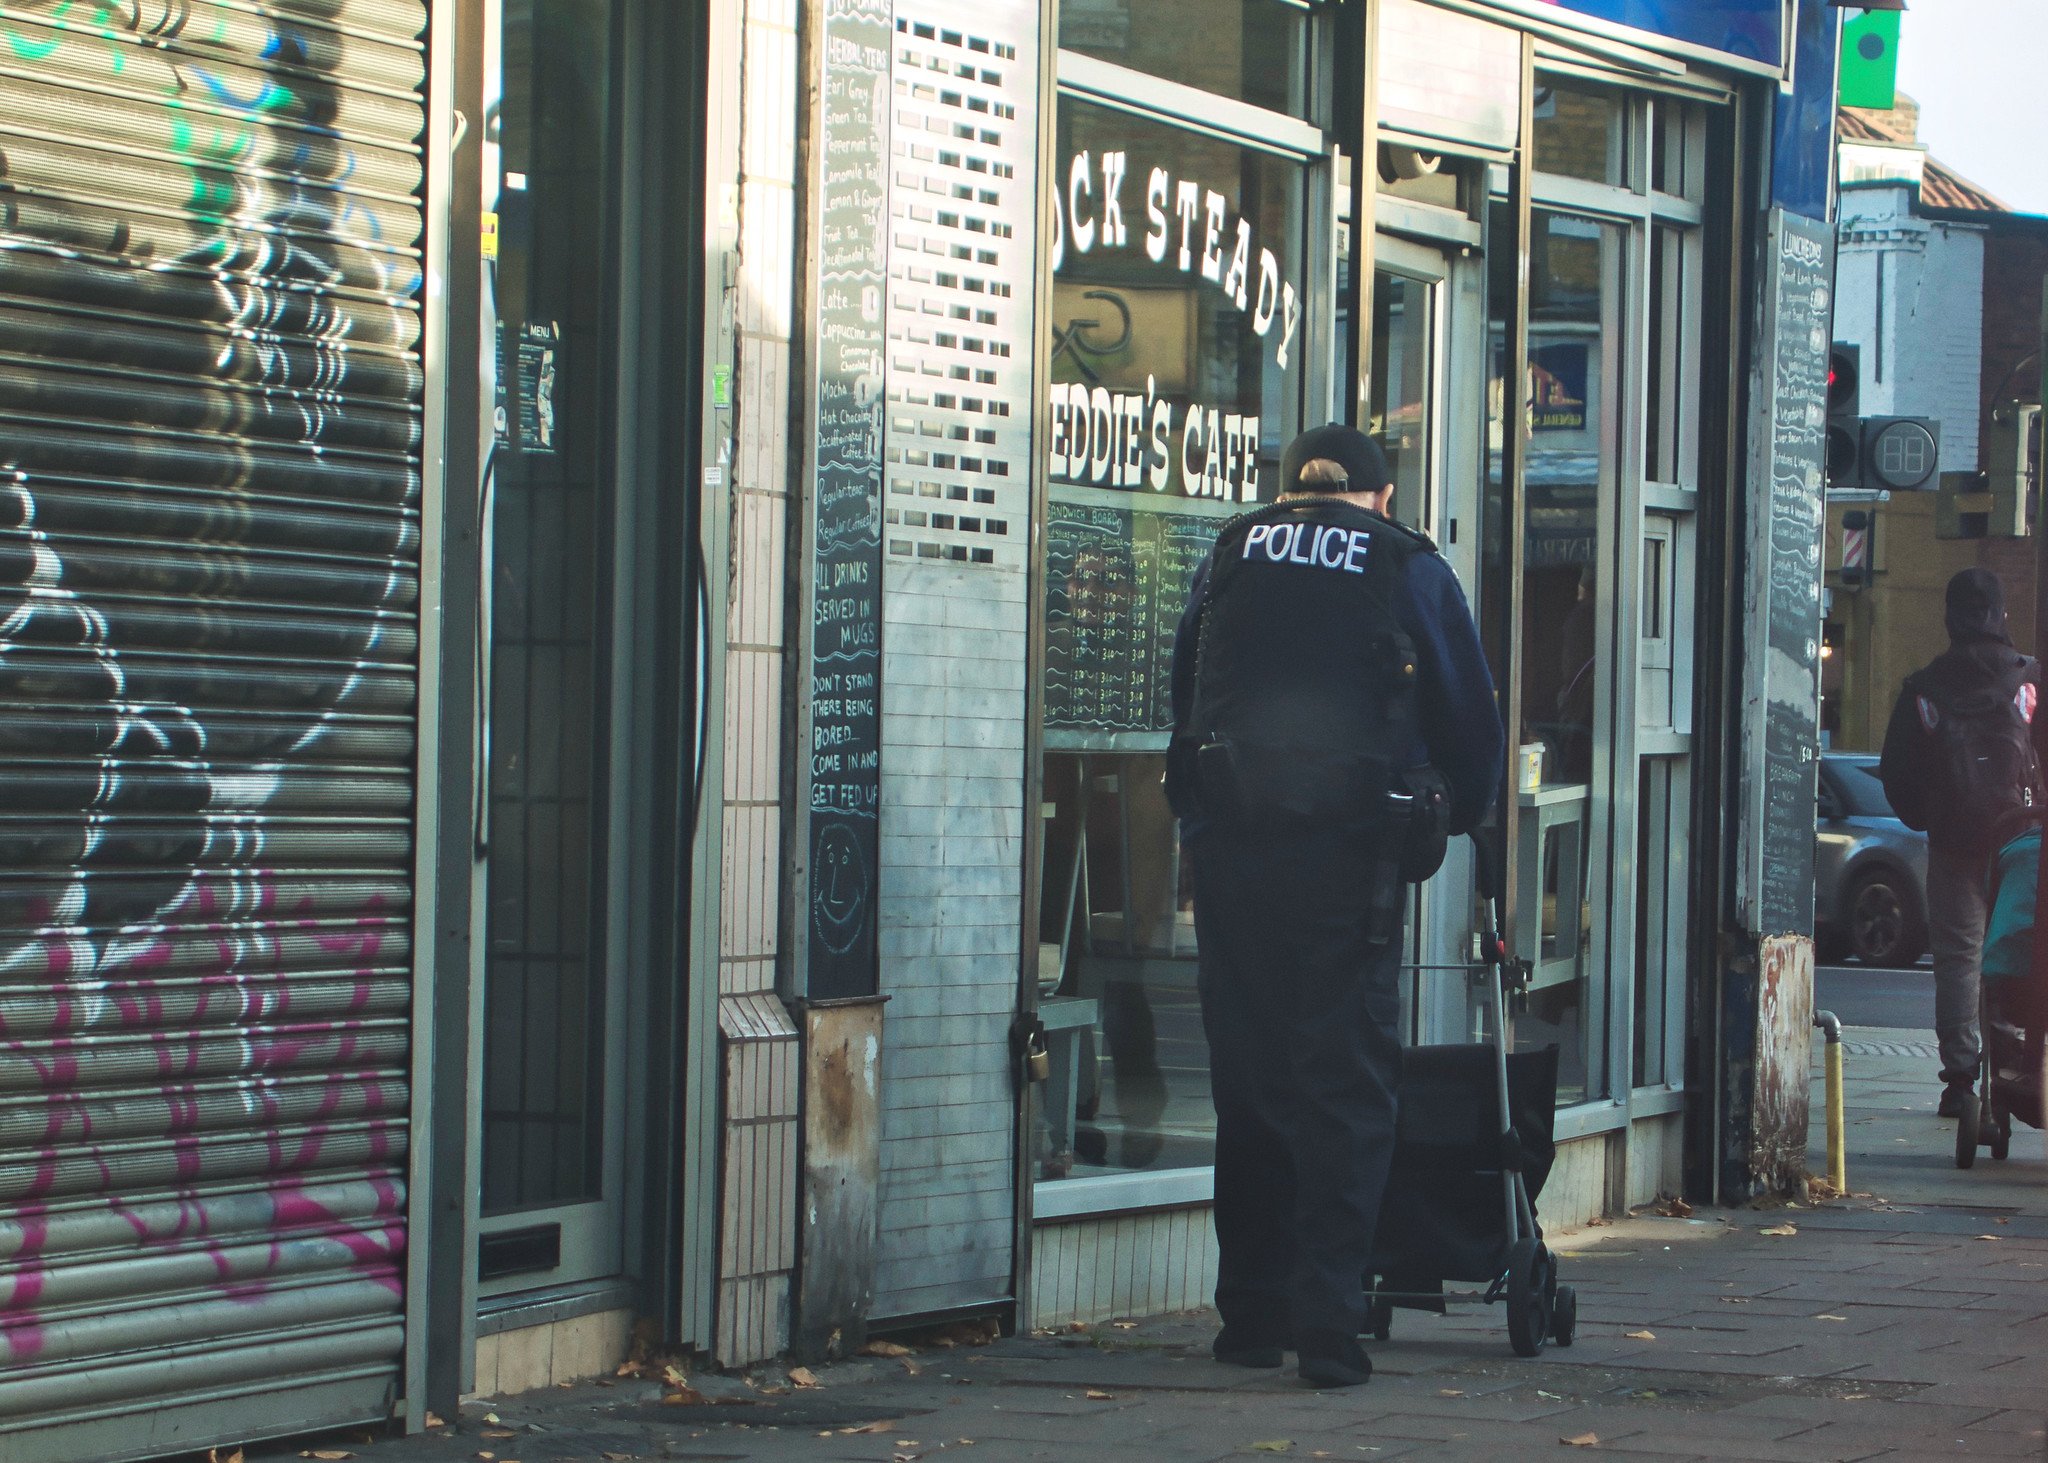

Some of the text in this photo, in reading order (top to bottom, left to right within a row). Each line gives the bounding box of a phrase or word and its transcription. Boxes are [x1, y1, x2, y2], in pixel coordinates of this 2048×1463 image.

[826, 75, 845, 97] Earl
[1784, 230, 1822, 259] LUNCHEONS
[1146, 167, 1301, 370] STEADY
[821, 288, 849, 310] Latte
[530, 324, 550, 339] MENU
[821, 380, 848, 401] Mocha
[821, 409, 872, 426] Hot Chocolate
[841, 443, 864, 460] Coffee
[1182, 404, 1259, 502] CAFE
[1092, 510, 1119, 526] BOARD
[1243, 523, 1371, 576] POLICE
[834, 561, 868, 588] DRINKS
[816, 598, 870, 625] SERVED IN
[841, 622, 875, 648] MUGS
[813, 672, 873, 696] DON'T STAND
[813, 698, 873, 717] THERE BEING
[812, 750, 878, 777] COME IN AND
[812, 783, 836, 806] GET
[840, 783, 862, 808] FED
